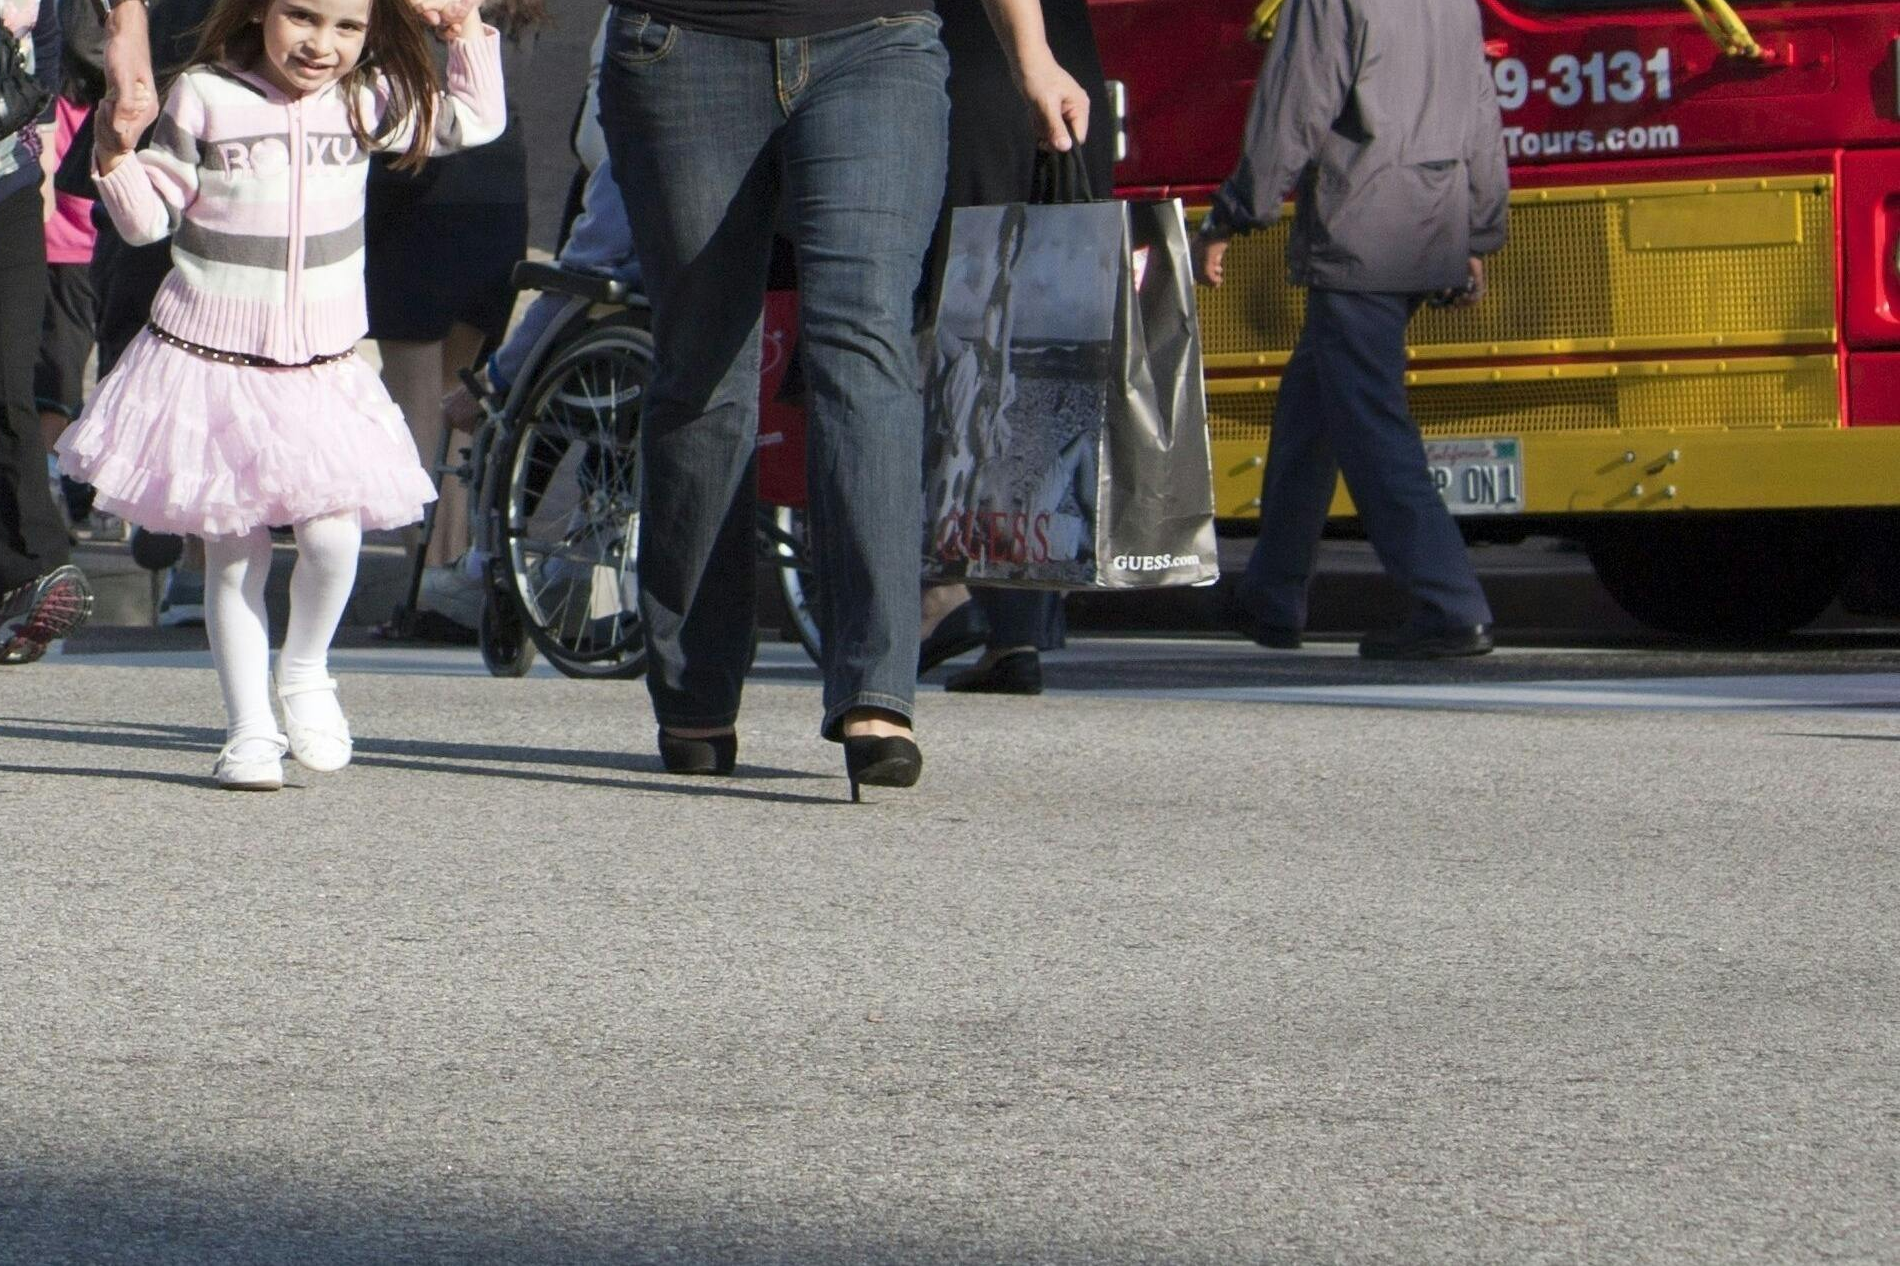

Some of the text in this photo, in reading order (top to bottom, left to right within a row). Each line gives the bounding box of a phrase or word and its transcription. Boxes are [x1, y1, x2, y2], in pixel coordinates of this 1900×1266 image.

[1494, 47, 1673, 111] 9-3131
[1502, 123, 1680, 157] Tours.com
[937, 510, 1050, 565] GUESS
[1113, 553, 1200, 572] GUESS.com
